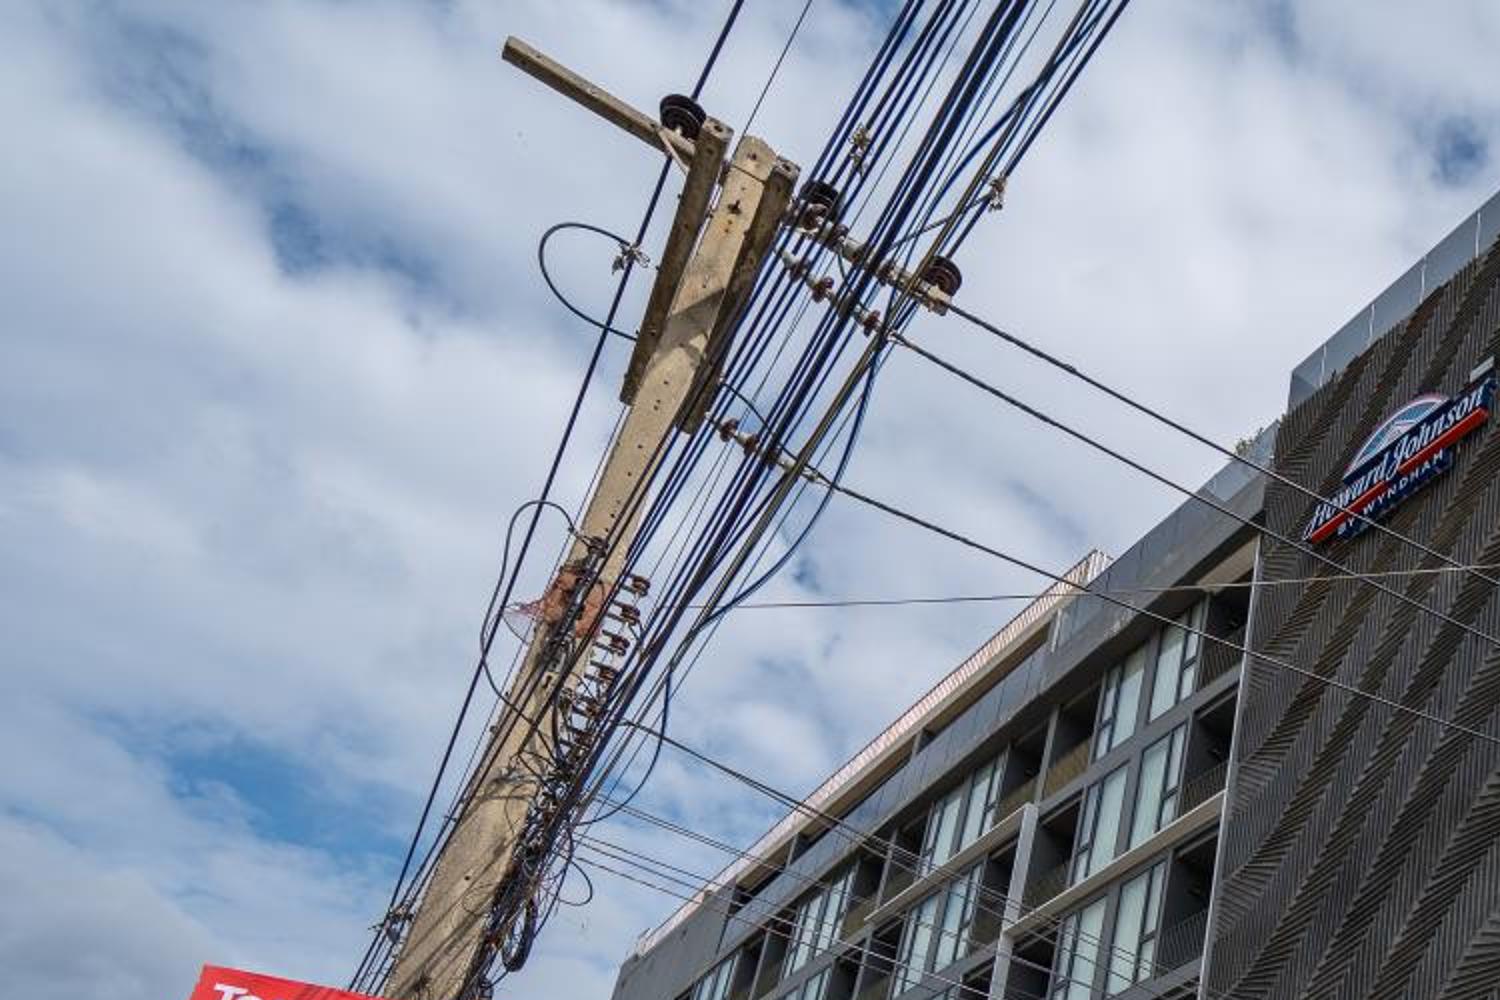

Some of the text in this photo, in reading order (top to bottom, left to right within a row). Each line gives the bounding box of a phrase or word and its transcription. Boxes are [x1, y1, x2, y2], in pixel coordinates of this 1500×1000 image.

[1303, 377, 1498, 541] Howard Johnson
[1362, 448, 1444, 516] WYNDHAM
